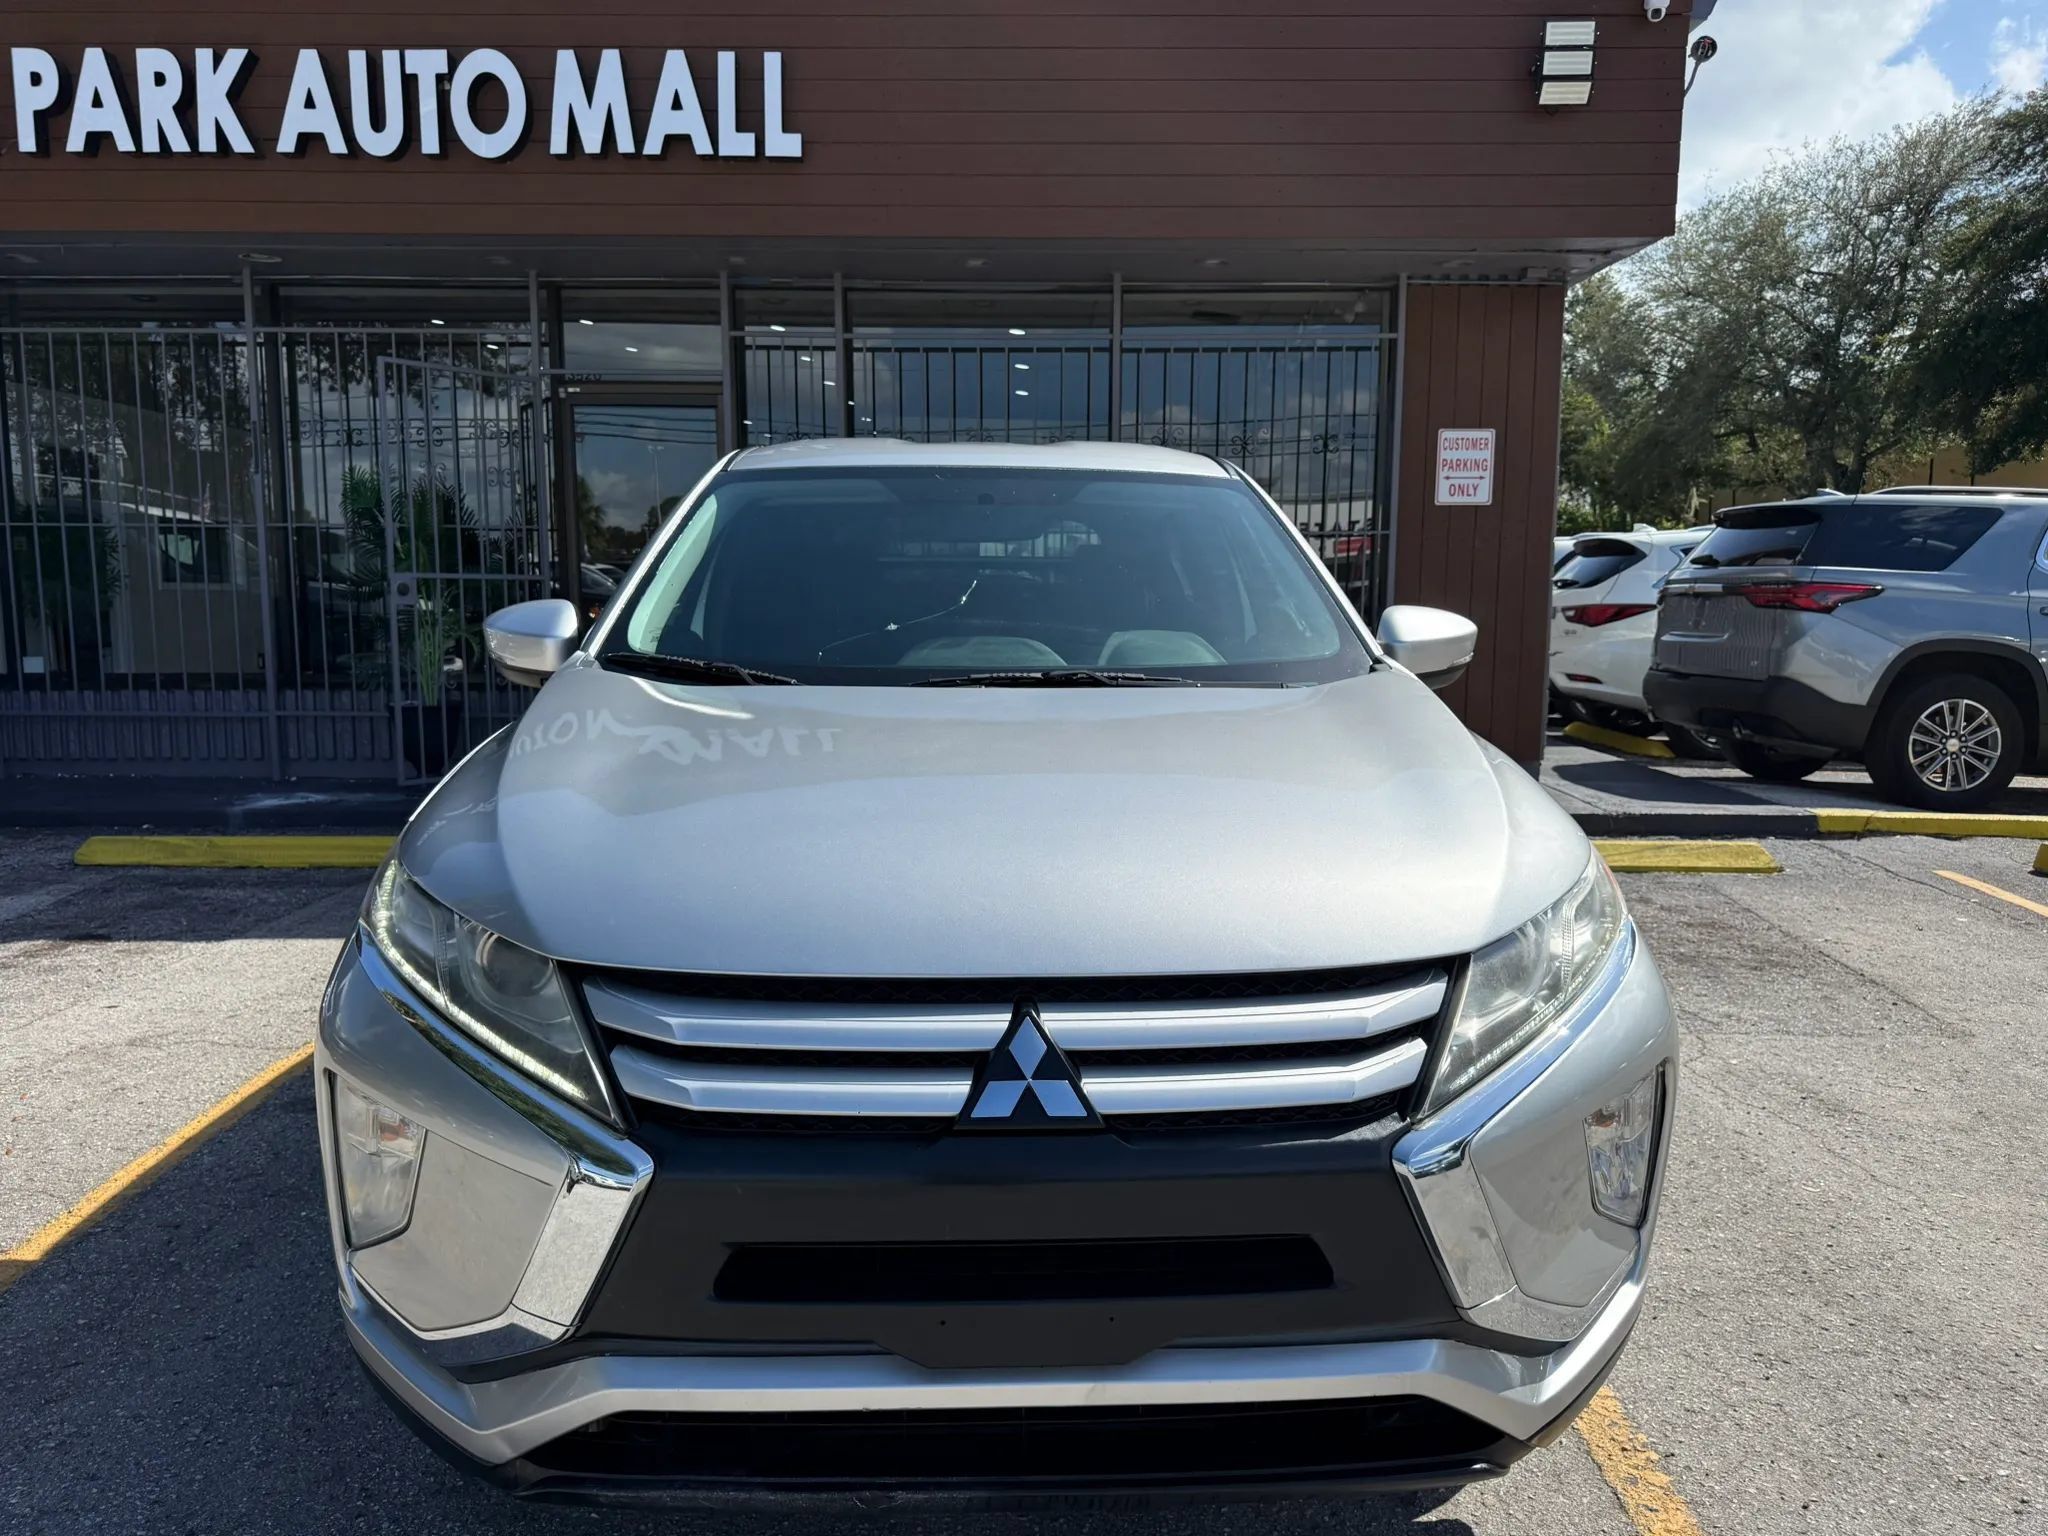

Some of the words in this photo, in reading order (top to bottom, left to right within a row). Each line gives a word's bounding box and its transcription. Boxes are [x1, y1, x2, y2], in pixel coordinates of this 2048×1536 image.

[12, 47, 256, 153] PARK
[277, 48, 527, 158] AUTO
[551, 49, 803, 157] MALL
[1442, 437, 1489, 451] CUSTOMER
[1441, 458, 1489, 472] PARKING
[1448, 483, 1480, 498] ONLY
